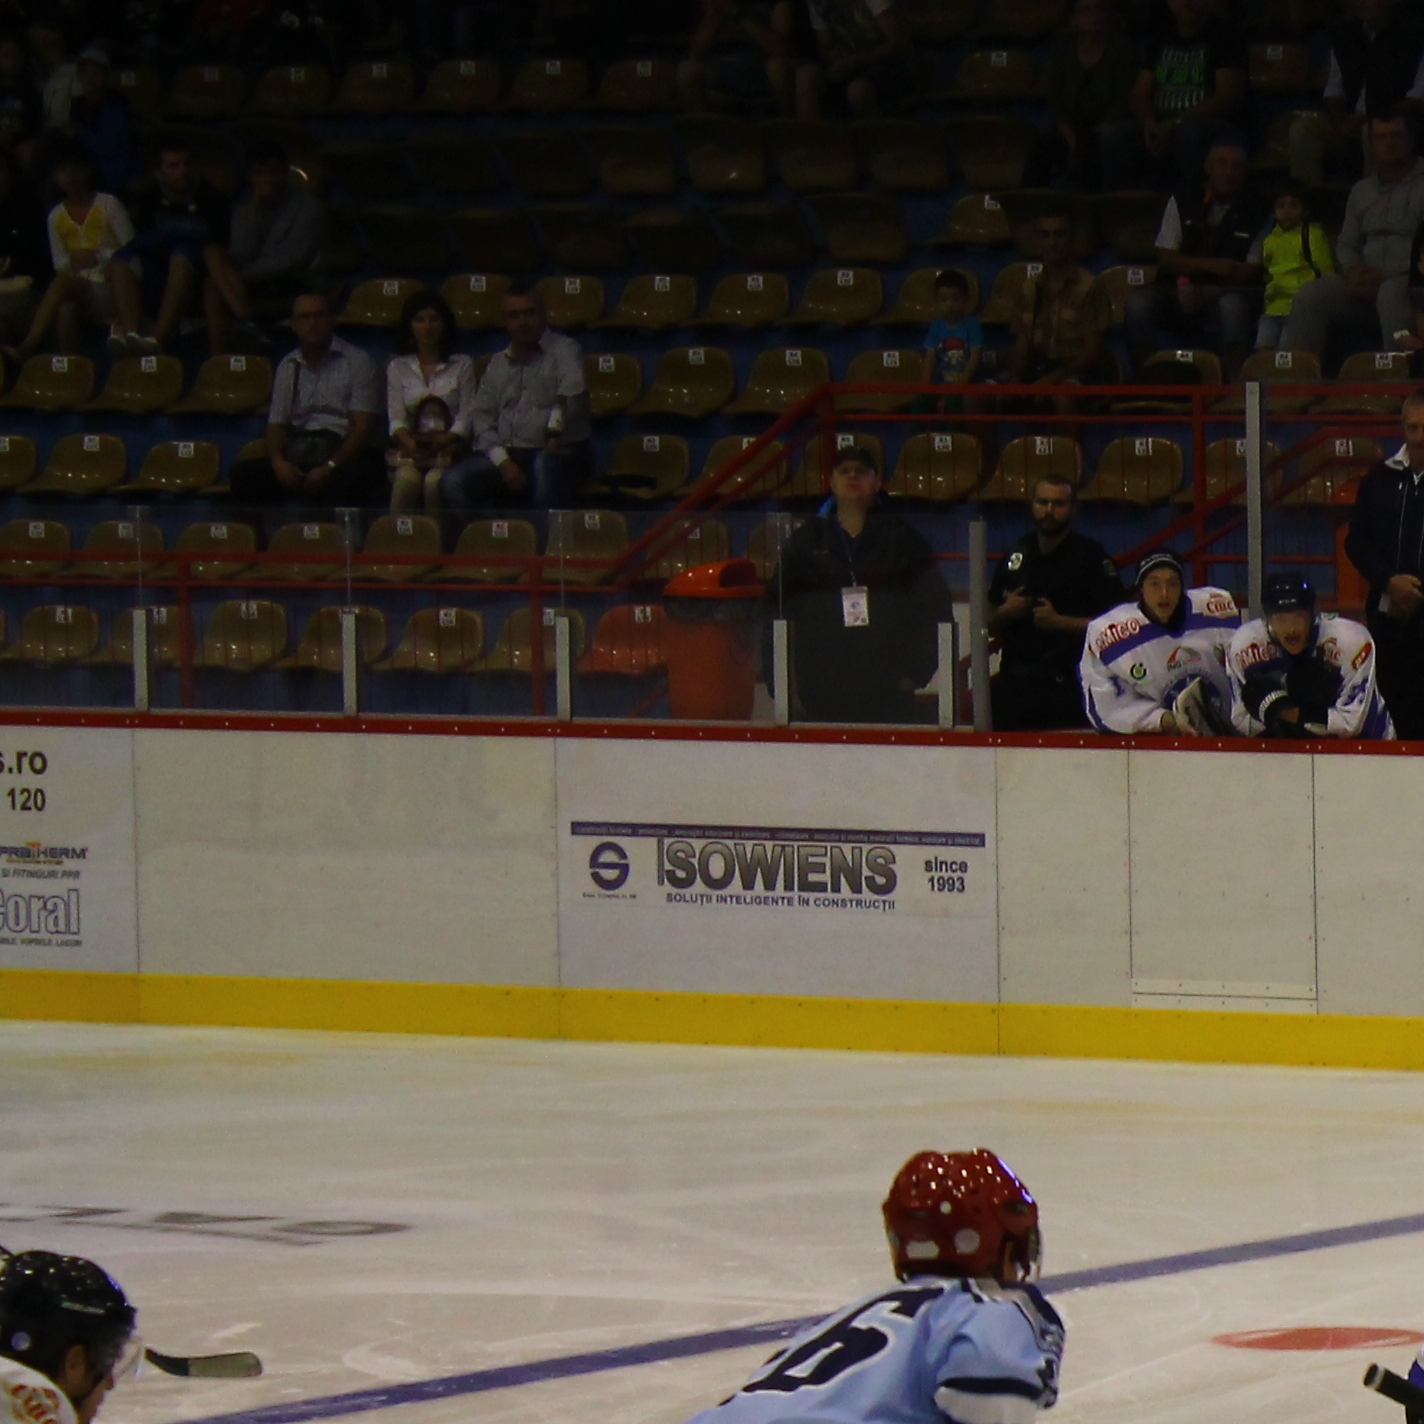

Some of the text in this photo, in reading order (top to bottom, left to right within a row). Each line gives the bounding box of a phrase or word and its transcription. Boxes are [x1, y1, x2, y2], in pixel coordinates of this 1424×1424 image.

[7, 788, 46, 812] 120
[924, 857, 968, 874] since
[927, 876, 966, 893] 1993
[716, 894, 794, 907] INTELIGENTE
